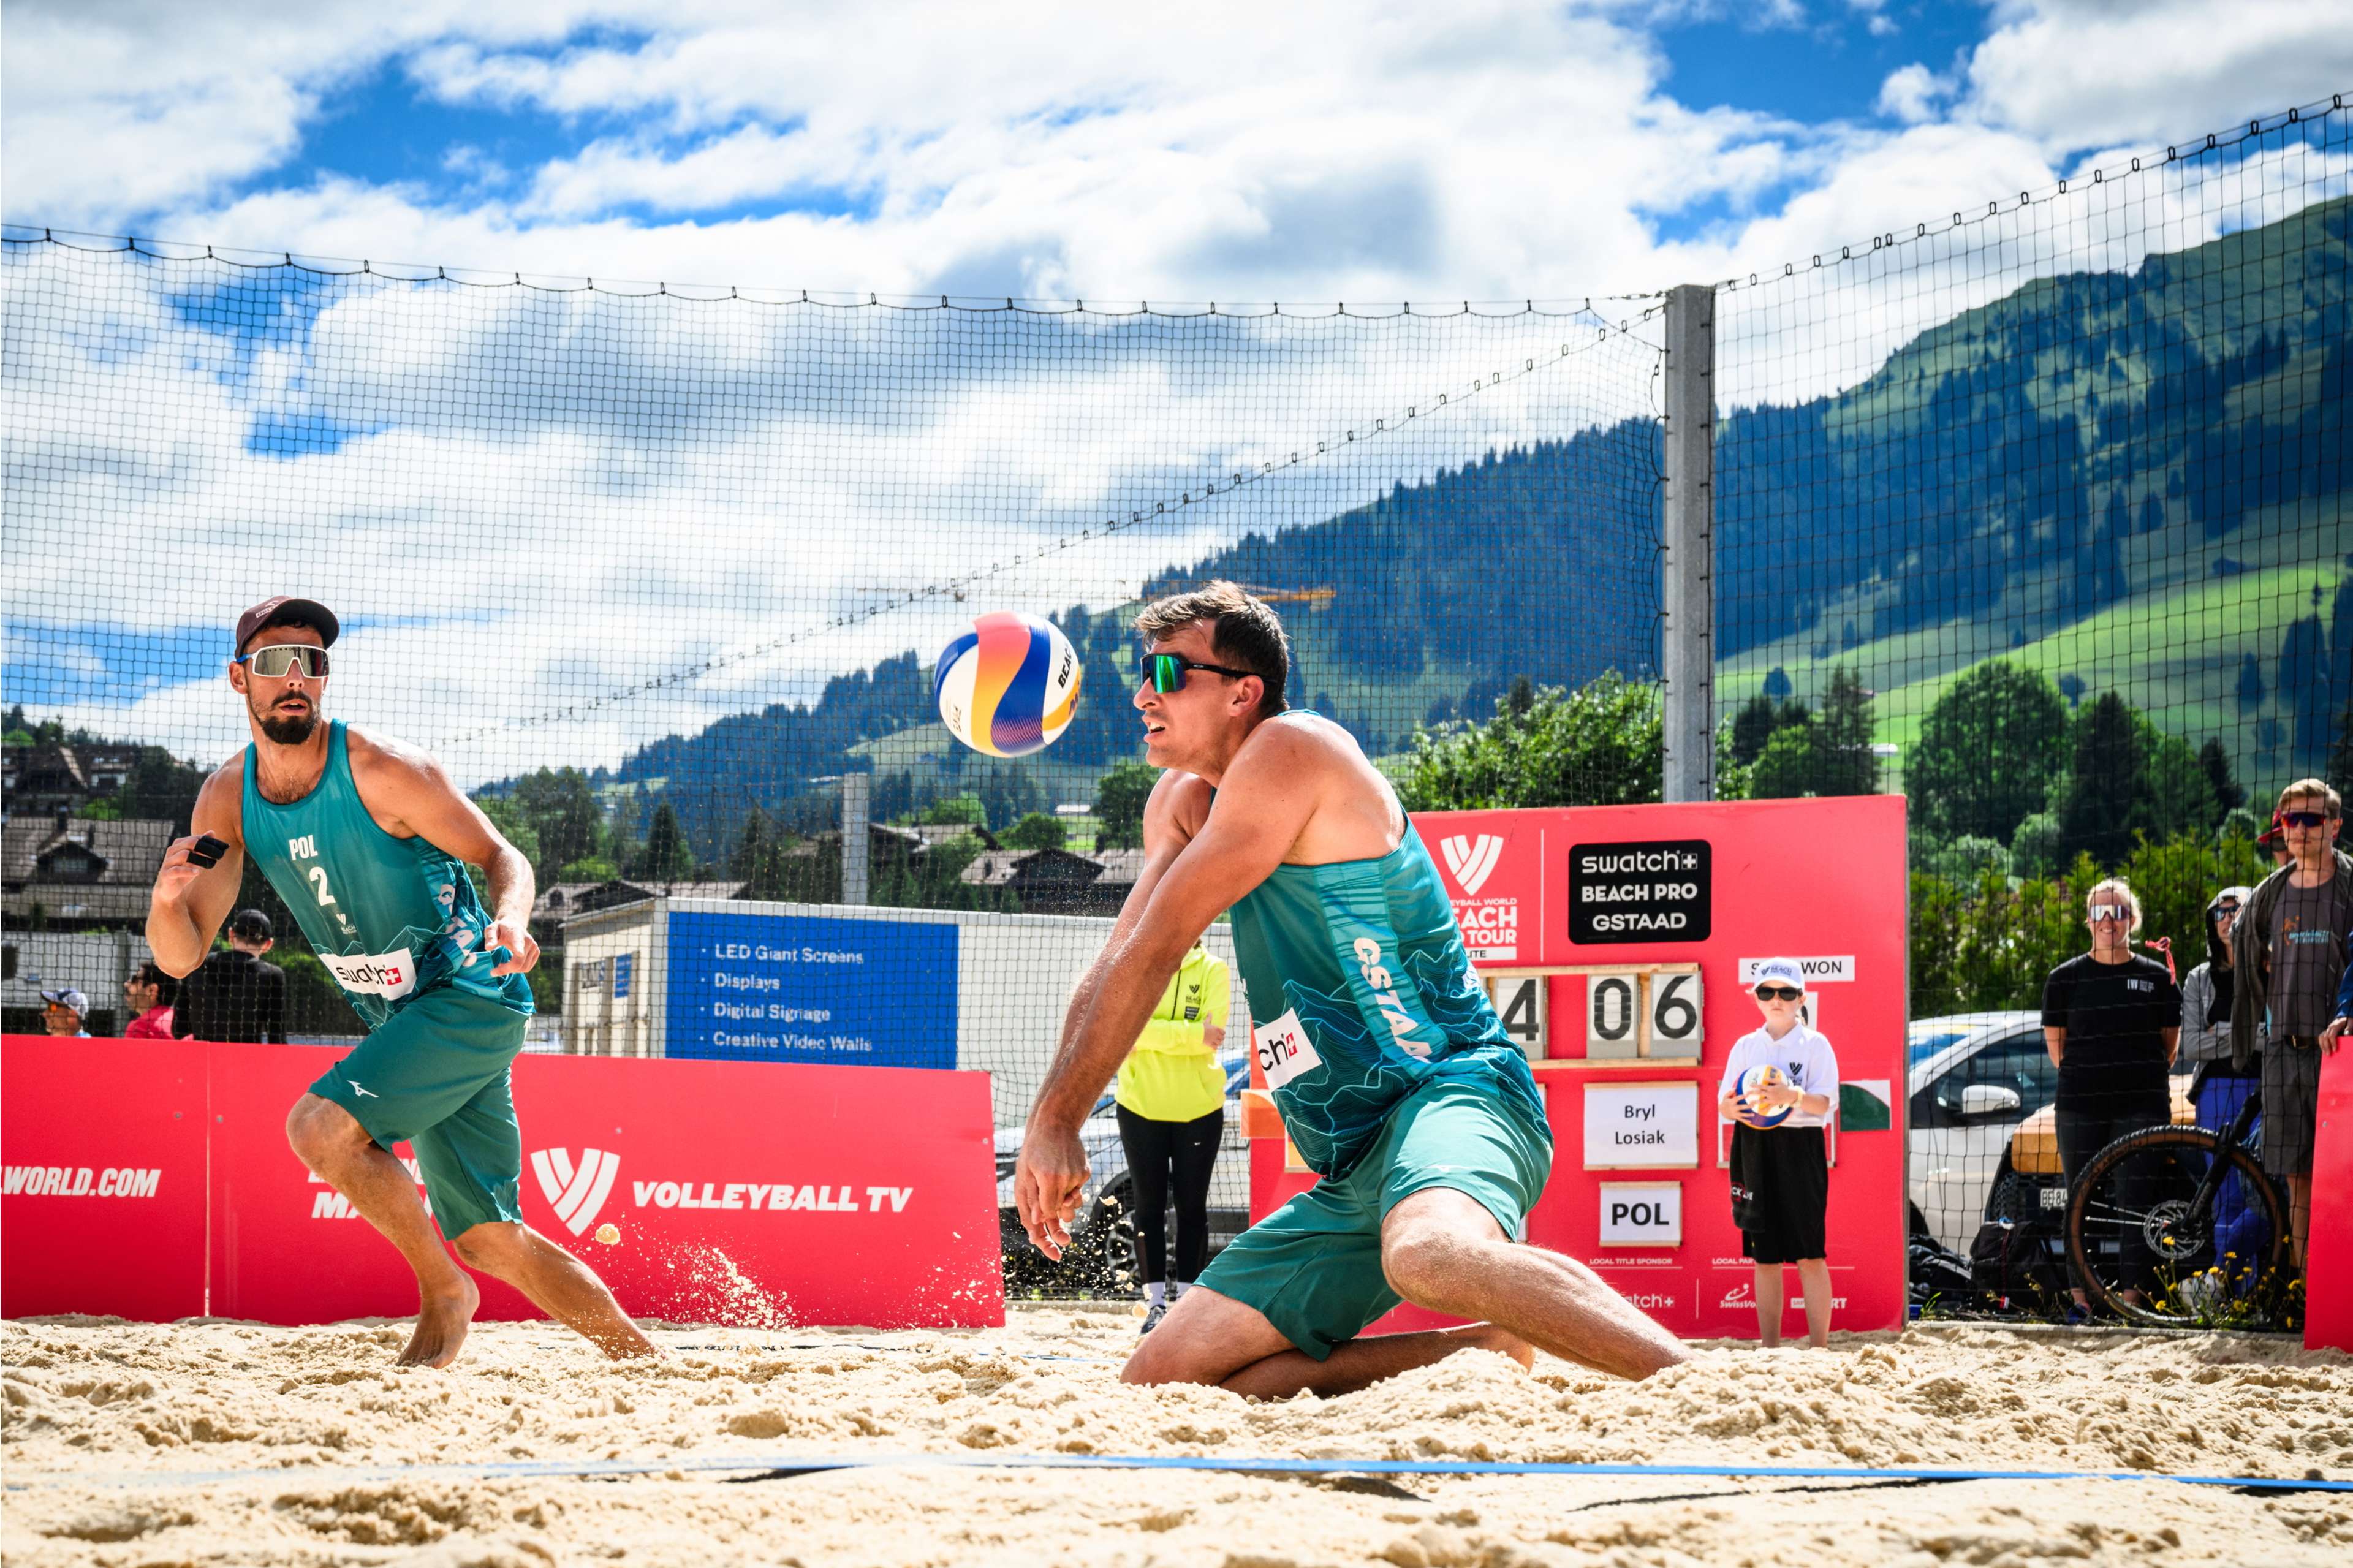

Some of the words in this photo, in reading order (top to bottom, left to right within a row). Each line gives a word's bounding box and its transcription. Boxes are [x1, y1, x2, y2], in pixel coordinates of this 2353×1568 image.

[289, 835, 318, 860] POL
[1582, 850, 1680, 873] swatch
[309, 866, 336, 906] 2
[1582, 885, 1649, 903] BEACH
[1654, 883, 1697, 900] PRO
[1453, 906, 1517, 929] ACH
[1593, 912, 1687, 931] GSTAAD
[1467, 928, 1518, 944] TOUR
[715, 944, 751, 960] LED
[755, 945, 798, 961] Giant
[801, 947, 863, 964] Screens
[1801, 961, 1842, 974] WON
[714, 972, 781, 993] Displays
[1354, 937, 1434, 1064] GSTAA
[714, 1002, 765, 1020] Digital
[768, 1004, 831, 1023] Signage
[713, 1031, 779, 1048] Creative
[782, 1034, 825, 1050] Video
[830, 1036, 872, 1051] Walls
[1624, 1104, 1656, 1121] Bryl
[1615, 1129, 1665, 1145] Losiak
[0, 1166, 162, 1197] WORLD.COM
[632, 1181, 859, 1212] VOLLEYBALL
[866, 1186, 914, 1213] TV
[1612, 1203, 1670, 1225] POL
[1719, 1300, 1756, 1309] SwissVo
